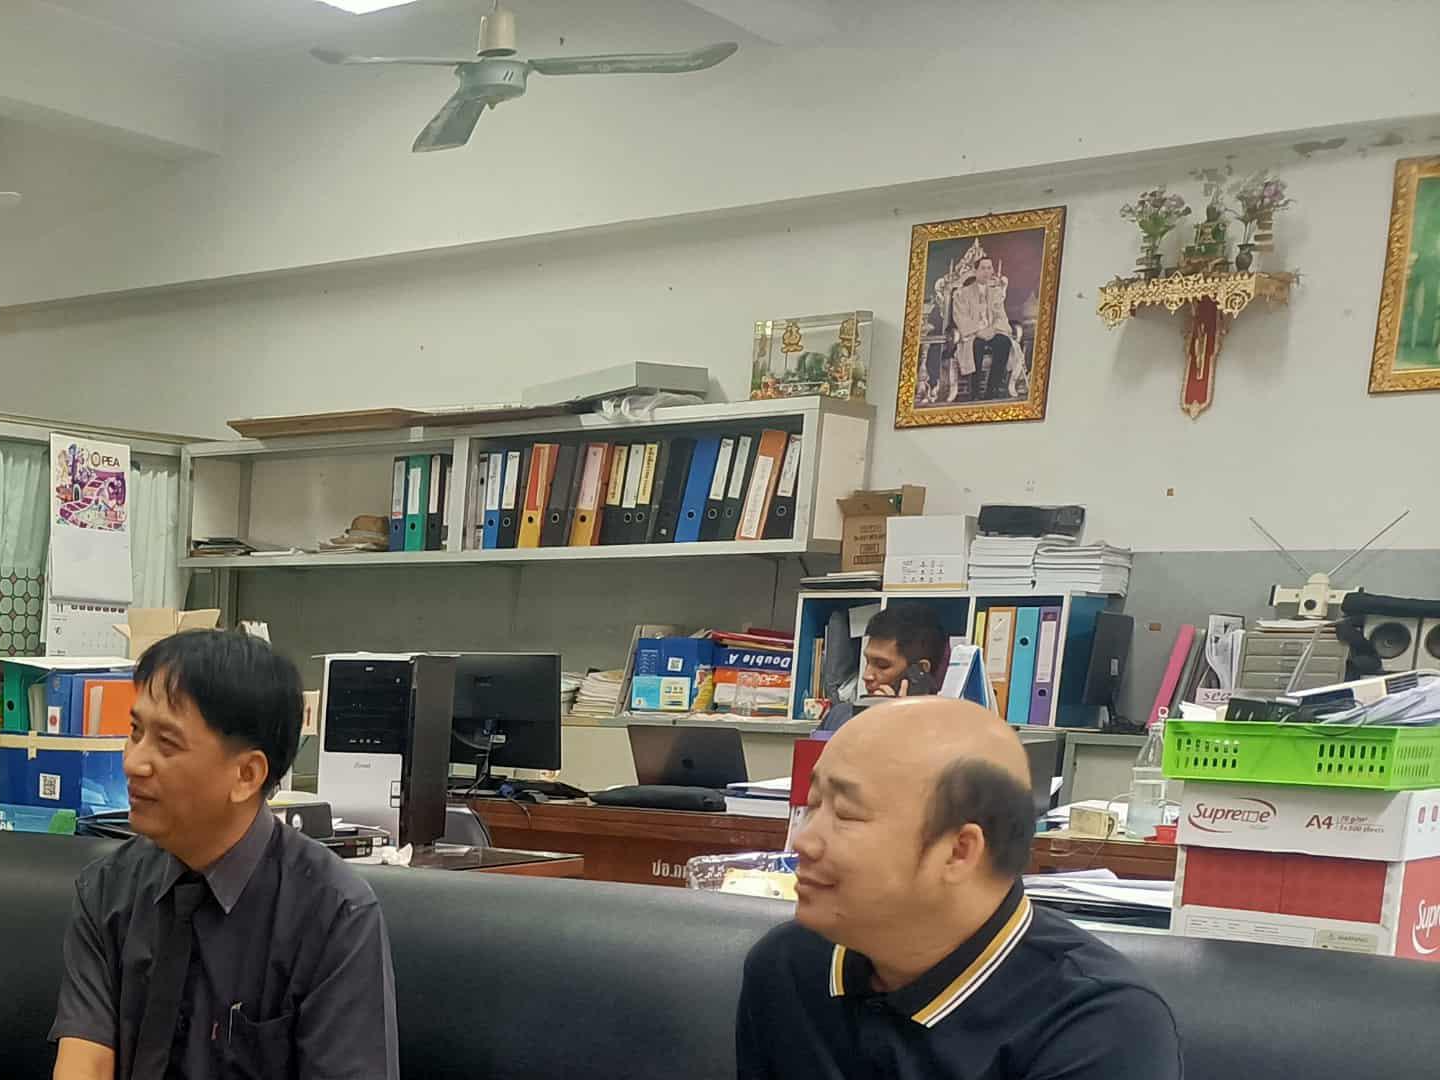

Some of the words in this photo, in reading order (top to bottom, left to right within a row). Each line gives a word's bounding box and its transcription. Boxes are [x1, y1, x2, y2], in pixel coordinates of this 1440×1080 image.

[101, 455, 121, 467] PEA
[742, 653, 791, 668] Double
[1305, 814, 1334, 829] A4
